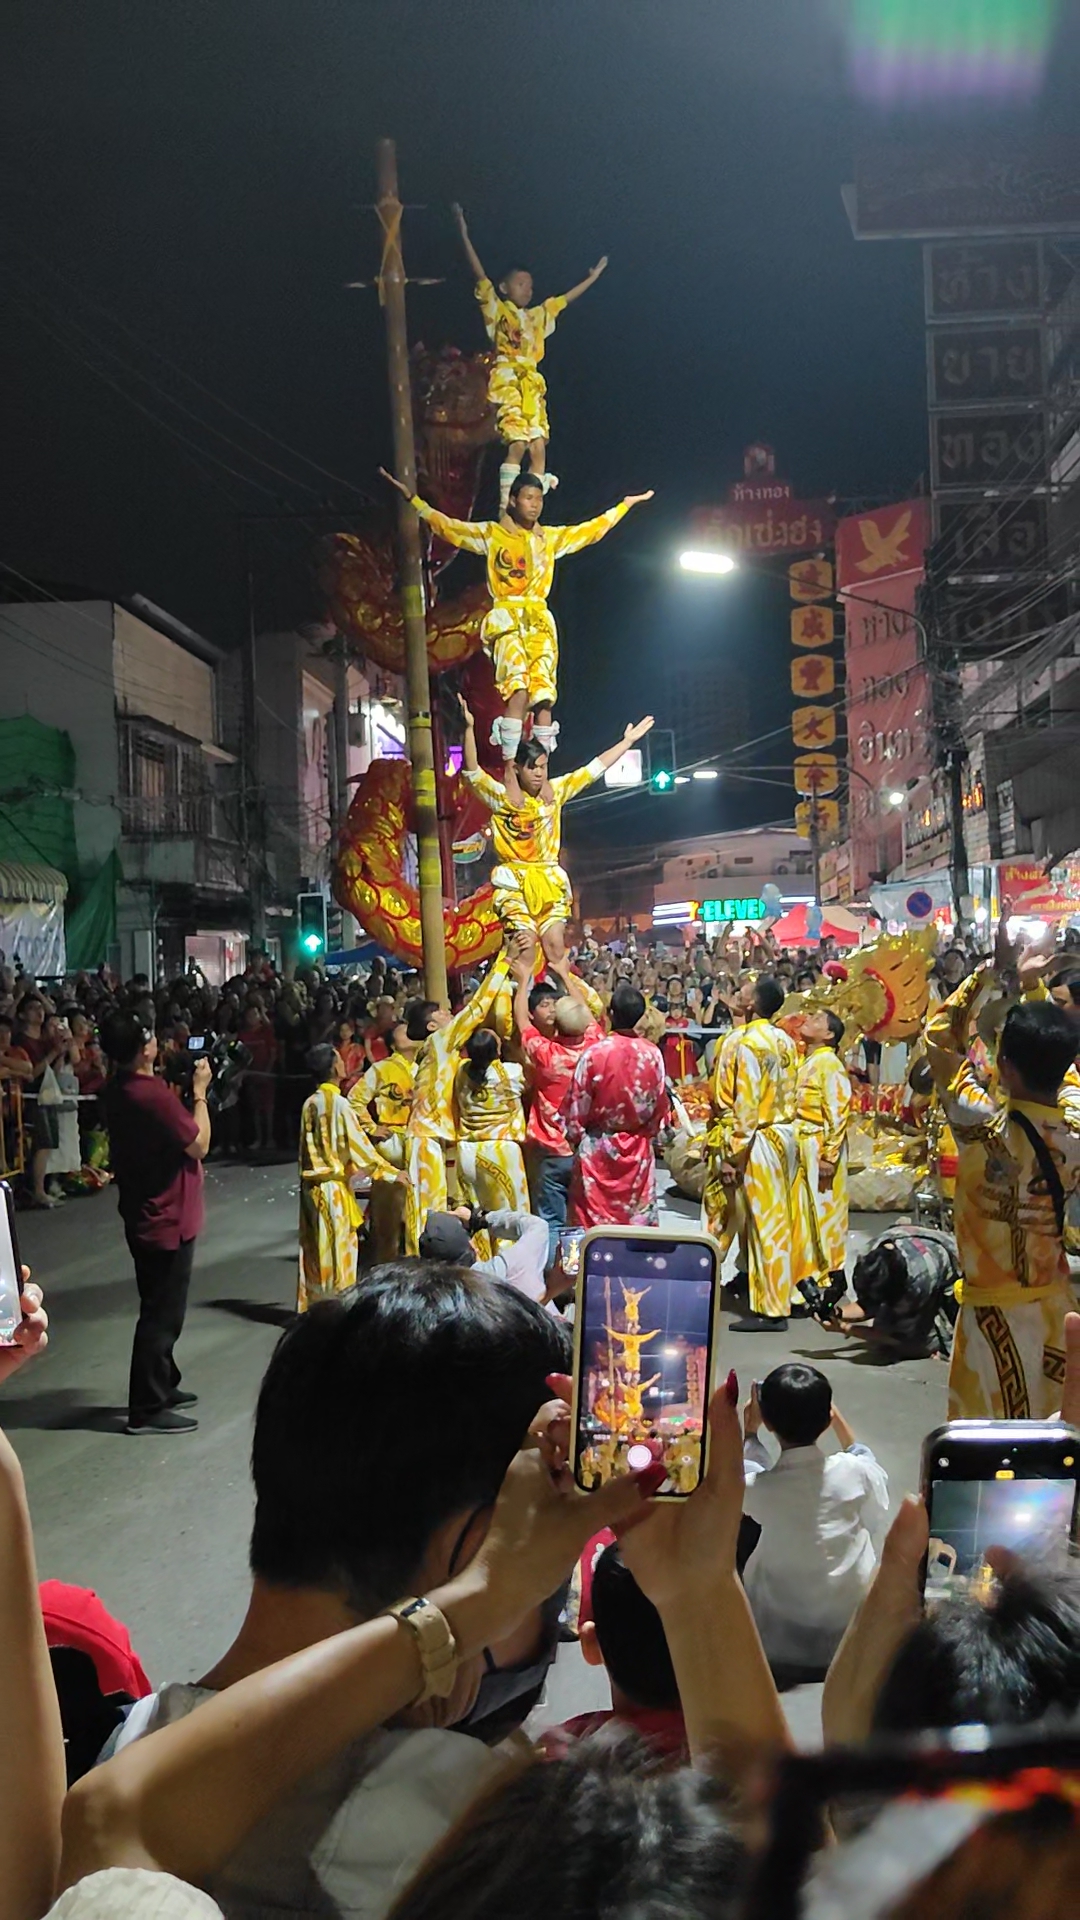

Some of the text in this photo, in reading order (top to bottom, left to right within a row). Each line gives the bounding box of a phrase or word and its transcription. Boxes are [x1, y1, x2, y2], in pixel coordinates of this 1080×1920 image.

[942, 345, 1034, 386] ขาย
[941, 428, 1043, 469] ทอง
[733, 483, 790, 502] ห้างทอง
